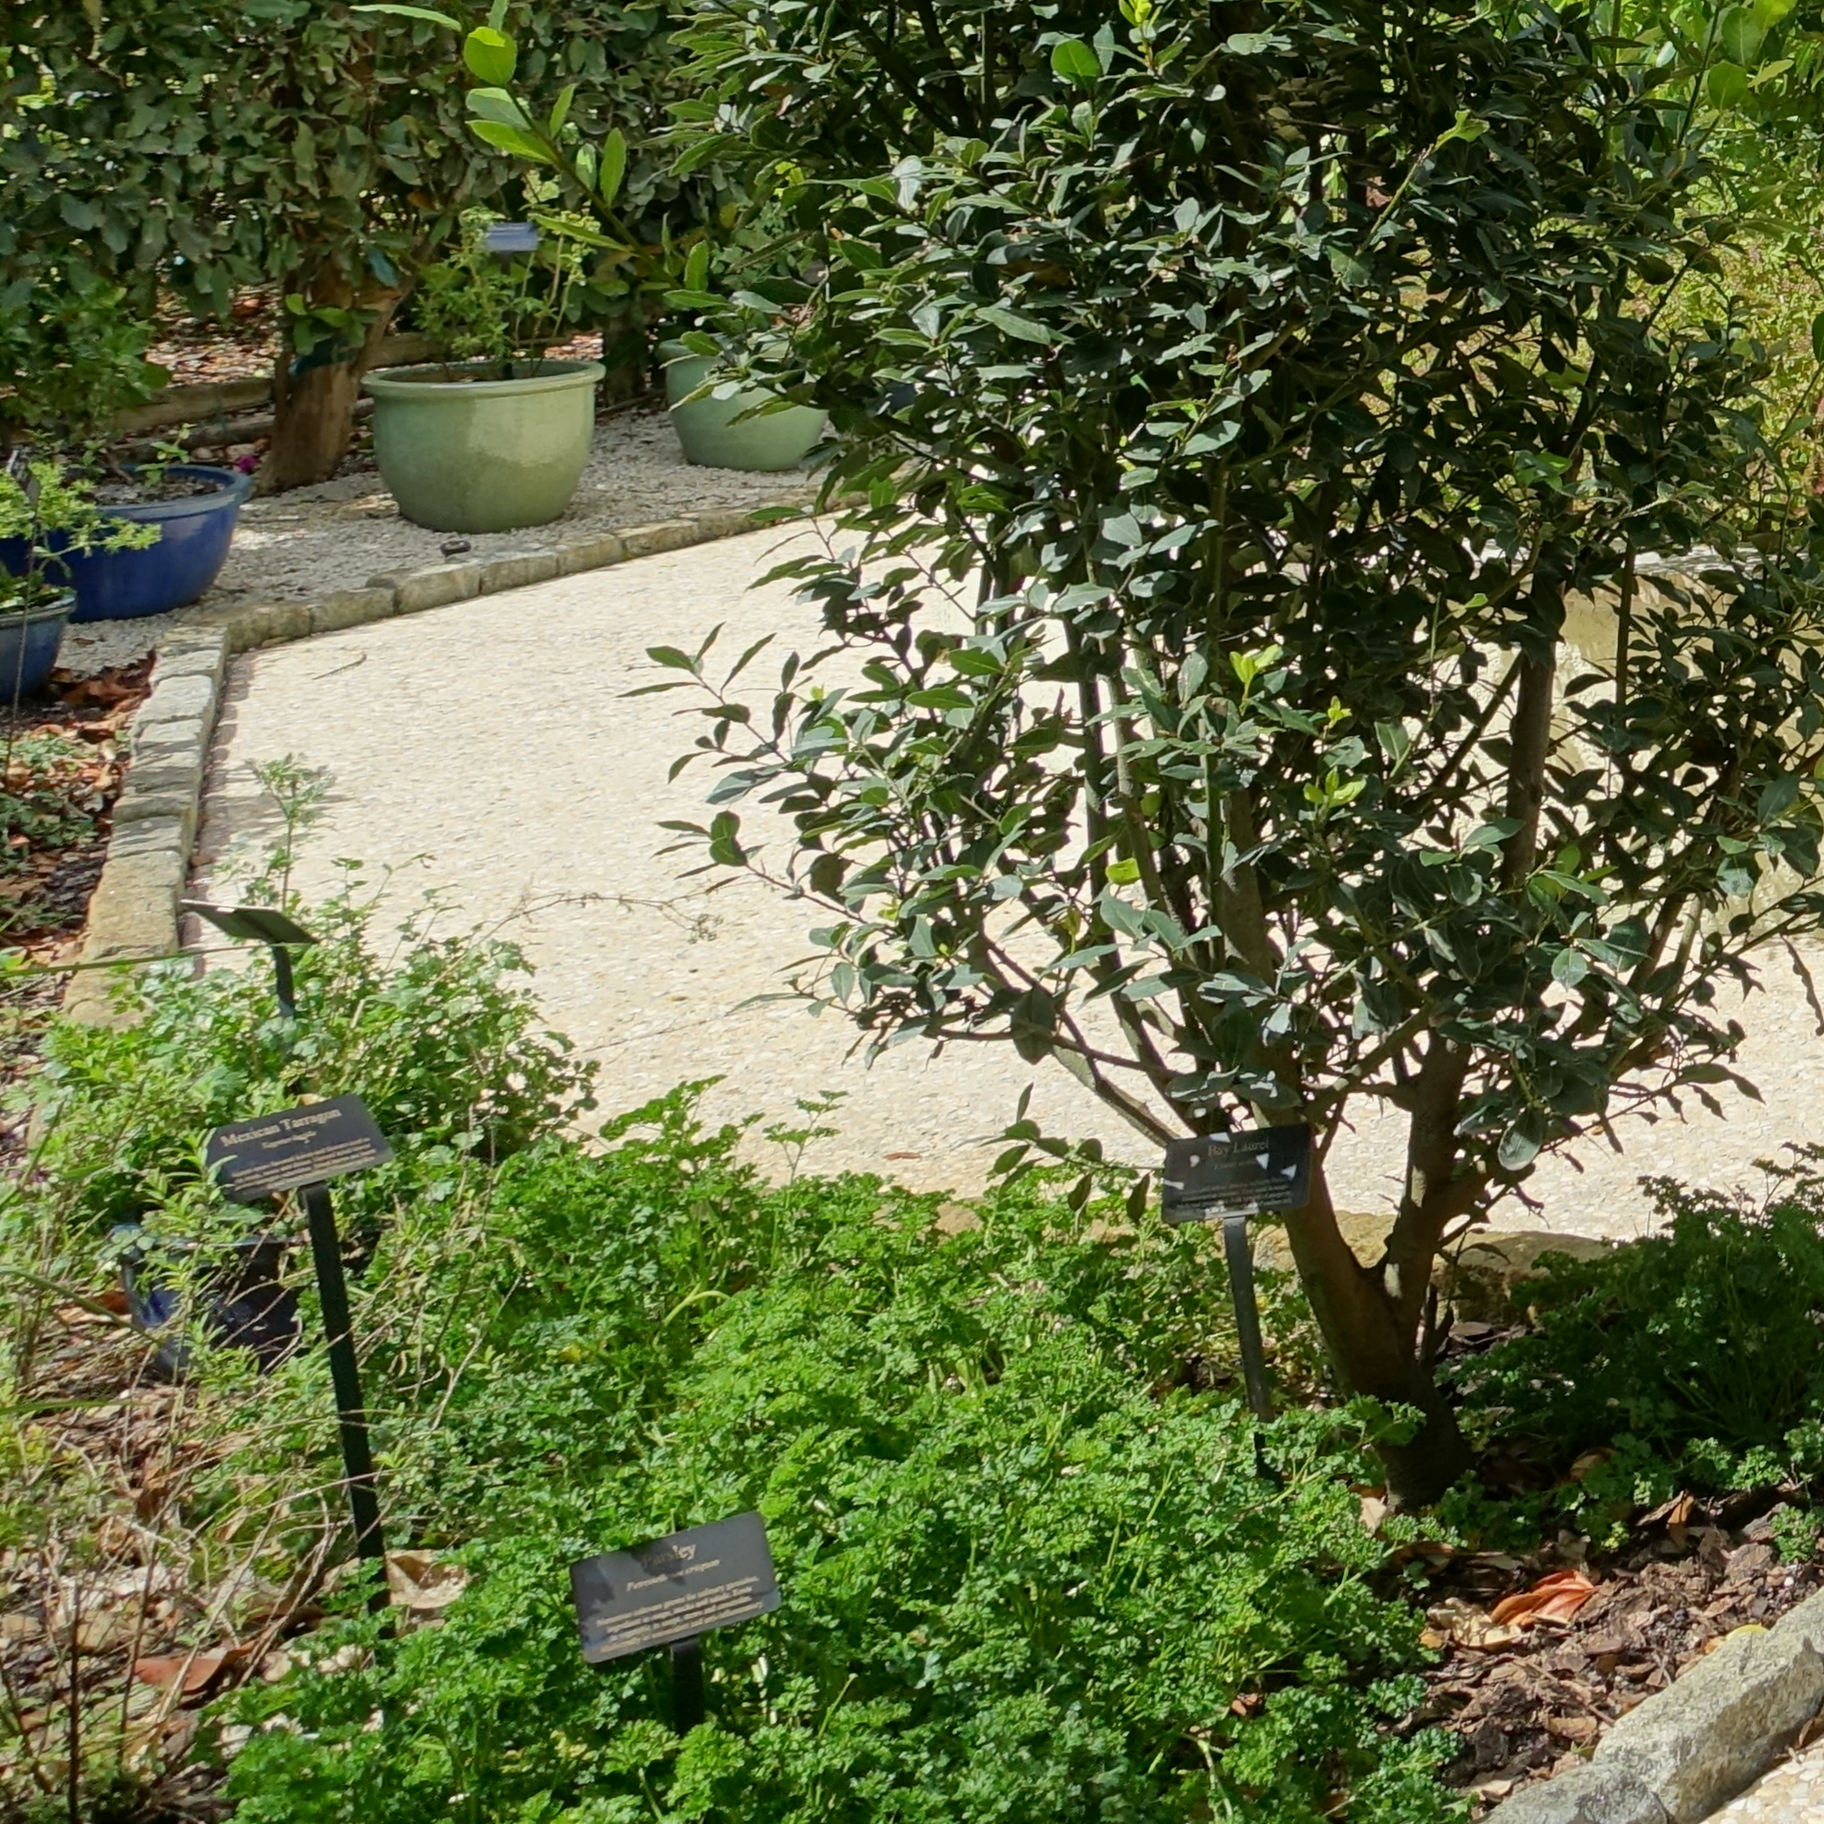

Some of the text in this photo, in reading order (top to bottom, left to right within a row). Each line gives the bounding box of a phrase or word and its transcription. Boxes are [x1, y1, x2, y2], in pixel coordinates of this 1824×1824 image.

[220, 1124, 280, 1147] Mexican
[279, 1109, 342, 1131] Tarragon
[643, 1544, 697, 1567] Parsley
